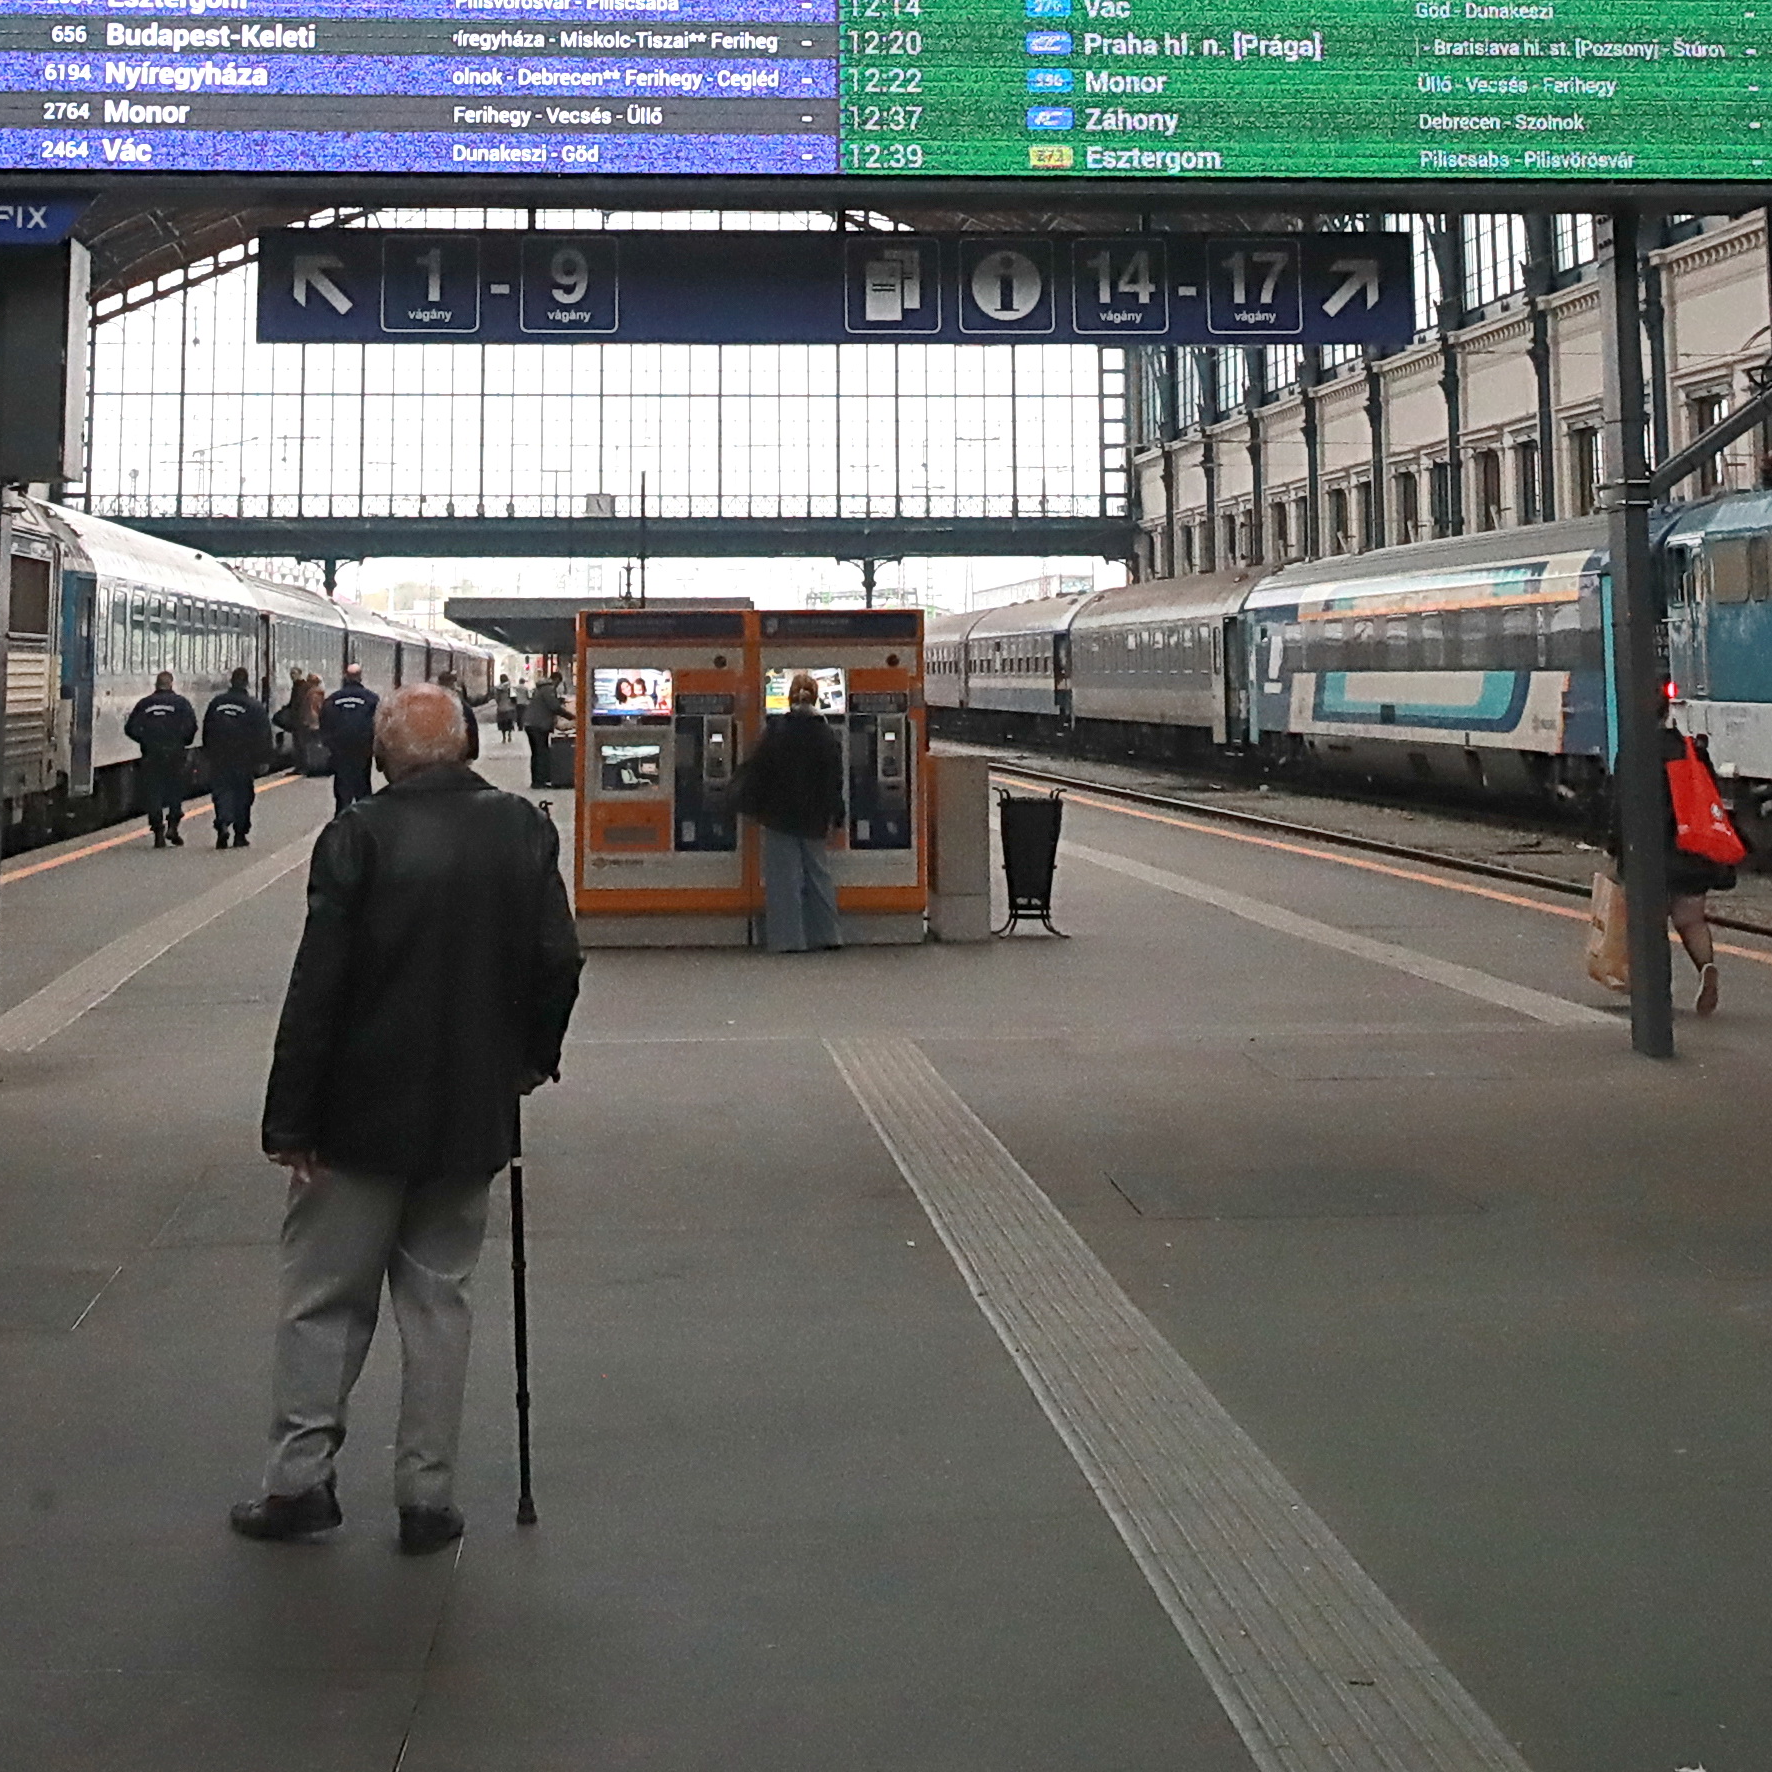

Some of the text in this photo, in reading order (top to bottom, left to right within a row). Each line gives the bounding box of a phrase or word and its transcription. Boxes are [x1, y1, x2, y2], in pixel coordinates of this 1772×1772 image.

[52, 26, 86, 42] 656
[106, 23, 315, 51] Budapest-Keleti
[848, 31, 921, 55] 12:20
[1085, 34, 1158, 56] Praha
[1165, 33, 1194, 57] hl.
[1203, 38, 1225, 57] n.
[1234, 32, 1323, 60] [Prága]
[848, 107, 922, 130] 12:37
[1086, 108, 1178, 135] Záhony
[1419, 114, 1501, 131] Debrecen
[1515, 114, 1584, 132] Szolnok
[42, 142, 88, 158] 2464
[103, 139, 152, 162] Vác
[453, 144, 546, 162] Dunakeszi
[561, 144, 599, 162] Göd
[550, 250, 588, 304] 9
[1087, 250, 1155, 304] 14
[1221, 252, 1288, 304] 17
[408, 308, 452, 323] vágány
[548, 308, 591, 323] vágány
[1100, 309, 1143, 324] vágány
[1234, 309, 1277, 324] vágány
